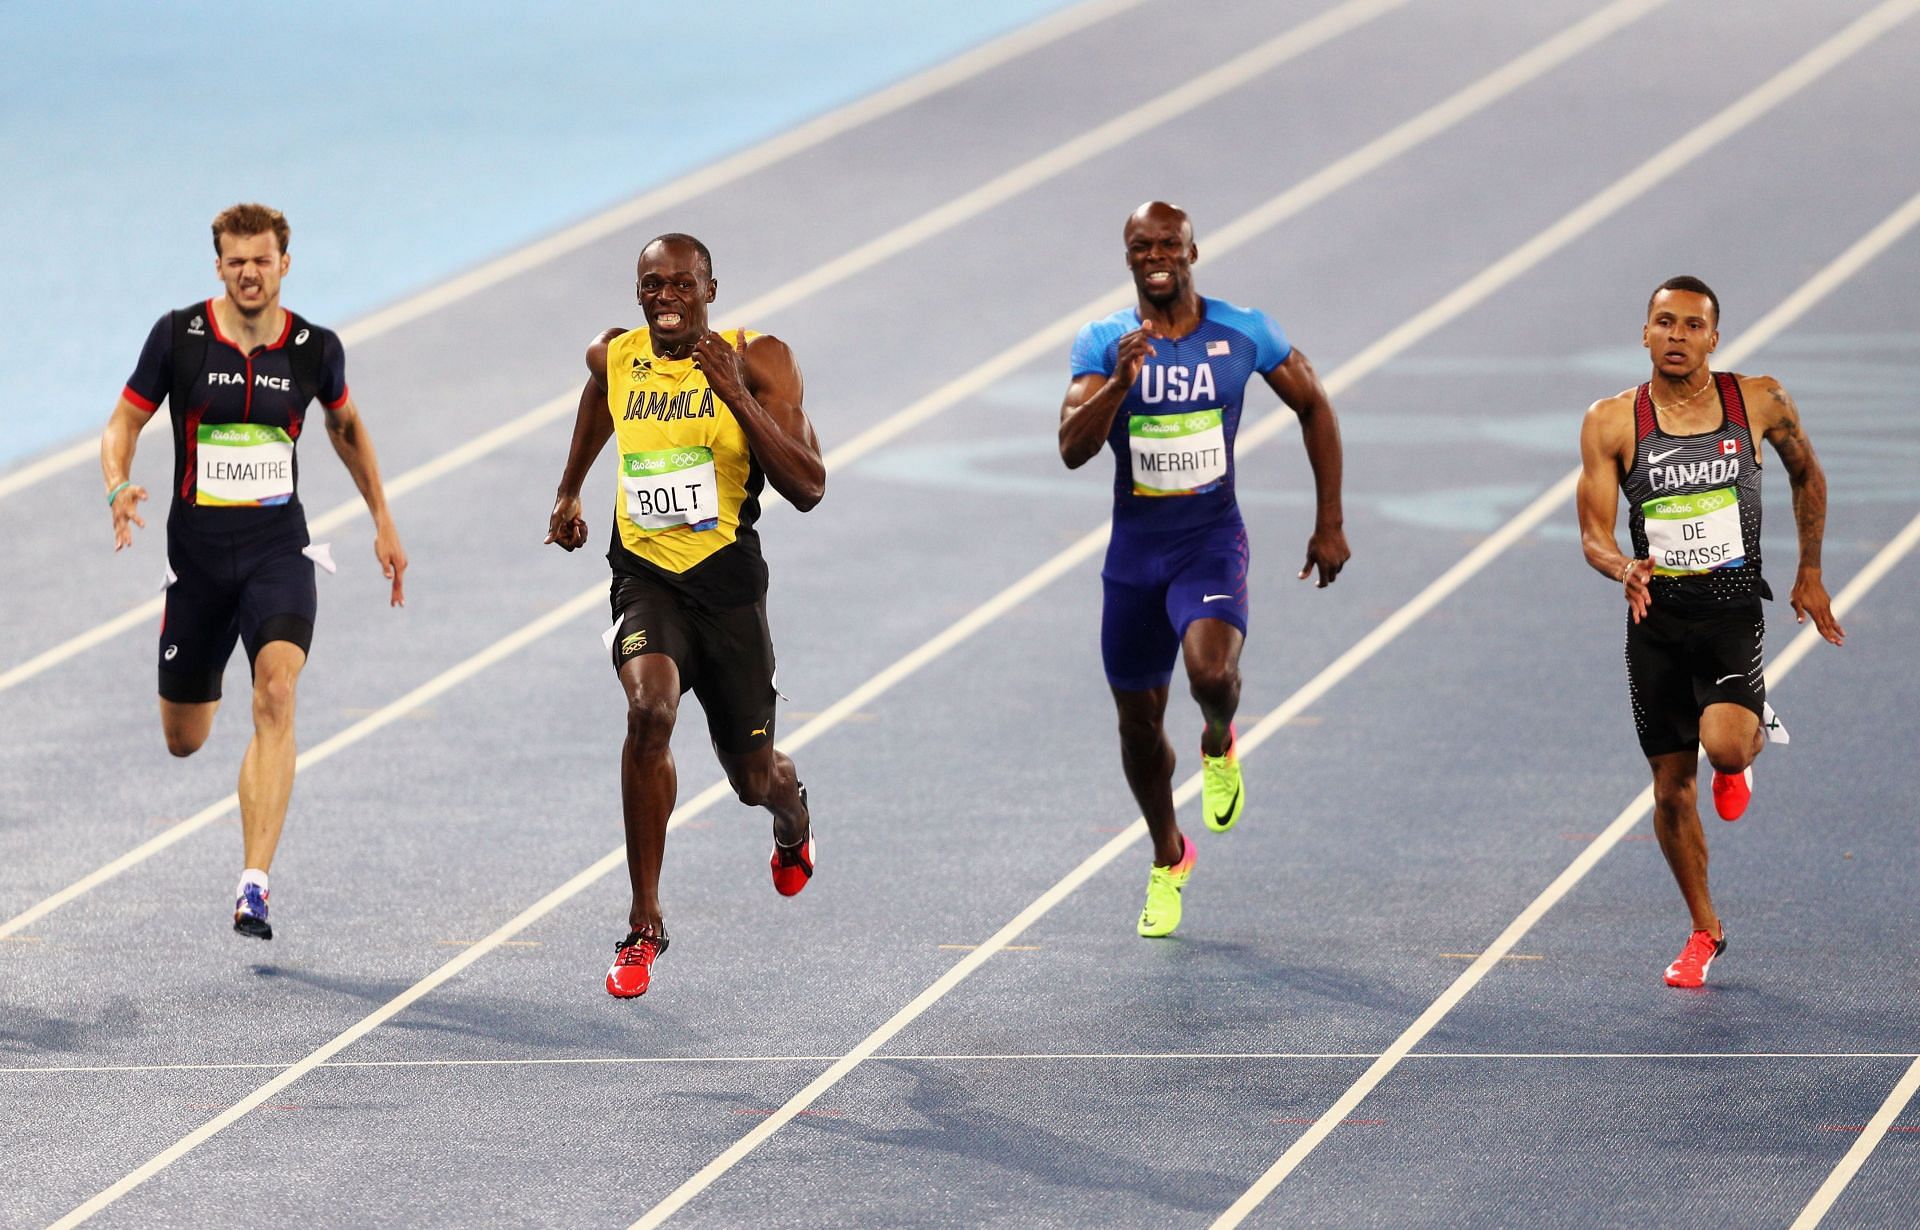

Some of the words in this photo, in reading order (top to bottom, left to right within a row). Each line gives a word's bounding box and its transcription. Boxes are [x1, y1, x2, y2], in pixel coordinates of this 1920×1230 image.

[1141, 362, 1216, 404] USA
[623, 388, 715, 422] JAMAICA
[206, 460, 288, 481] LEMAITRE
[1140, 447, 1220, 473] MERRITT
[1648, 459, 1740, 492] CANADA
[637, 483, 702, 516] BOLT
[1682, 521, 1707, 541] DE
[1664, 542, 1731, 568] GRASSE
